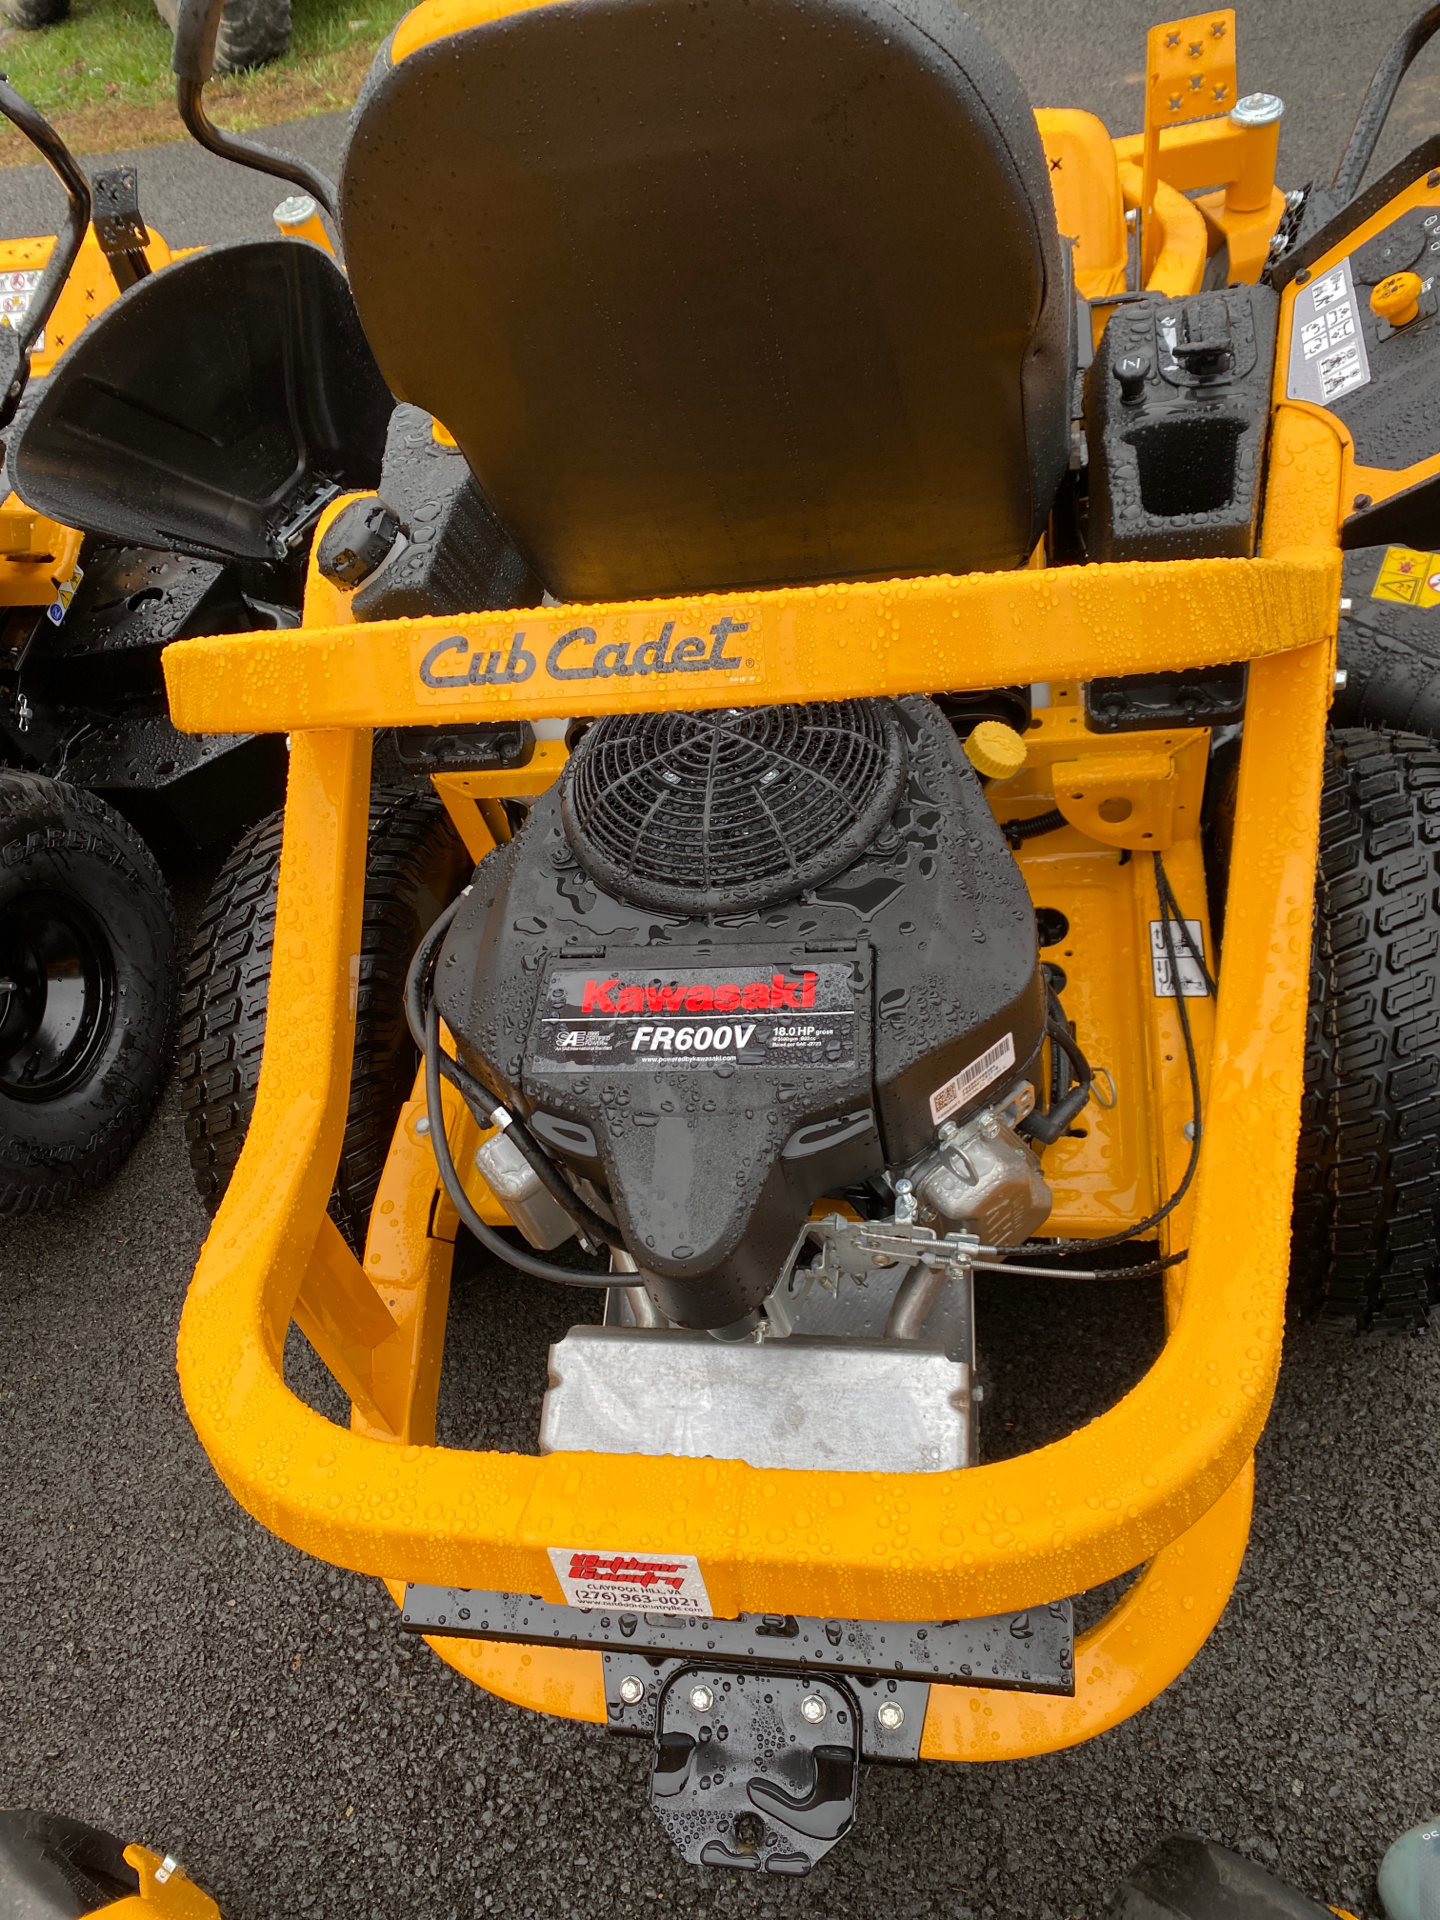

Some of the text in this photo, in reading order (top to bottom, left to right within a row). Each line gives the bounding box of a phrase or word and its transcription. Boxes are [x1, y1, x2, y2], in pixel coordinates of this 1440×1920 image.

[418, 616, 750, 688] Cub Cadet
[581, 972, 817, 1013] Kawasaki
[631, 1024, 757, 1050] FR600V
[773, 1027, 795, 1036] 18.0
[797, 1026, 815, 1036] HP
[575, 1590, 699, 1607] (276) 963-0021
[587, 1584, 638, 1593] CLAYPOOL
